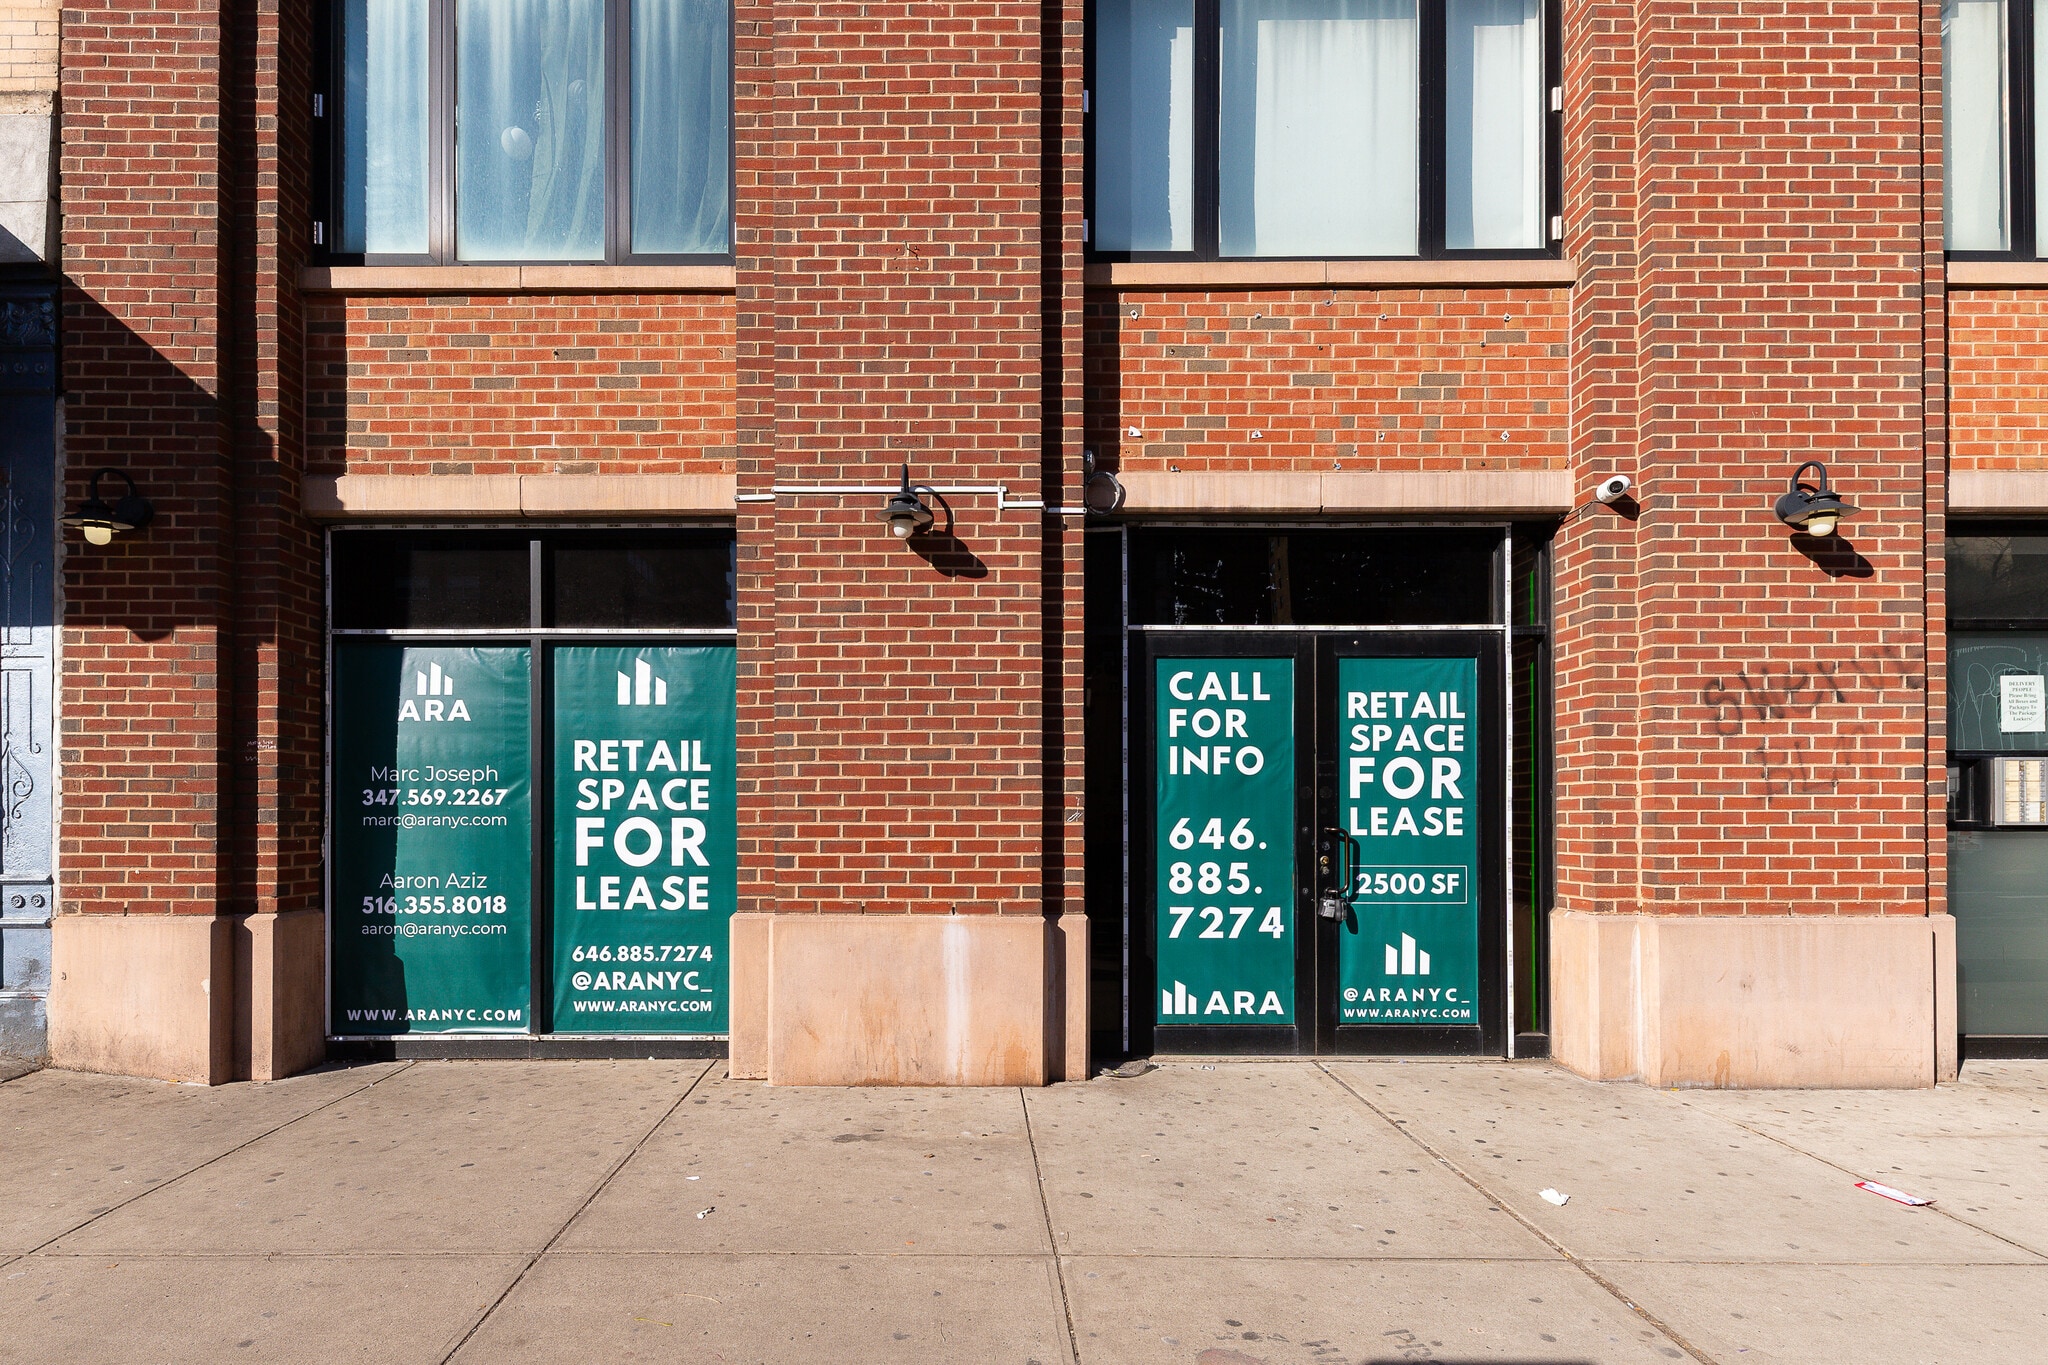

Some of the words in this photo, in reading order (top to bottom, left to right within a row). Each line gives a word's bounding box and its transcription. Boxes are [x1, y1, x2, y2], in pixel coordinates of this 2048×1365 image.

[1170, 672, 1270, 700] CALL
[397, 699, 471, 721] ARA
[1348, 692, 1465, 718] RETAIL
[1170, 709, 1248, 737] FOR
[1350, 725, 1463, 751] SPACE
[575, 740, 711, 771] RETAIL
[1170, 746, 1263, 775] INFO
[371, 766, 419, 782] Marc
[424, 765, 498, 786] Joseph
[1350, 757, 1463, 799] FOR
[362, 788, 507, 806] 347.569.2267
[576, 779, 709, 810] SPACE
[363, 813, 507, 829] marc@aranyc.com
[1351, 807, 1463, 836] LEASE
[576, 817, 709, 867] FOR
[1170, 818, 1266, 850] 646.
[380, 873, 439, 888] Aaron
[445, 872, 487, 888] Aziz
[1169, 862, 1262, 894] 885.
[1357, 874, 1425, 894] 2500
[1431, 874, 1459, 894] SF
[577, 876, 708, 910] LEASE
[363, 896, 506, 914] 516.355.8018
[362, 923, 506, 936] aaron@aranyc.com
[1169, 907, 1284, 938] 7274
[573, 946, 712, 961] 646.885.7274
[572, 972, 712, 992] @ARANYC_
[574, 1001, 711, 1011] WWW.ARANYC.COM
[1204, 991, 1284, 1014] ARA
[1344, 988, 1469, 1003] @ARANYC_
[348, 1009, 521, 1021] WWW.ARANYC.COM
[1344, 1009, 1469, 1017] WWW.ARANYC.COM
